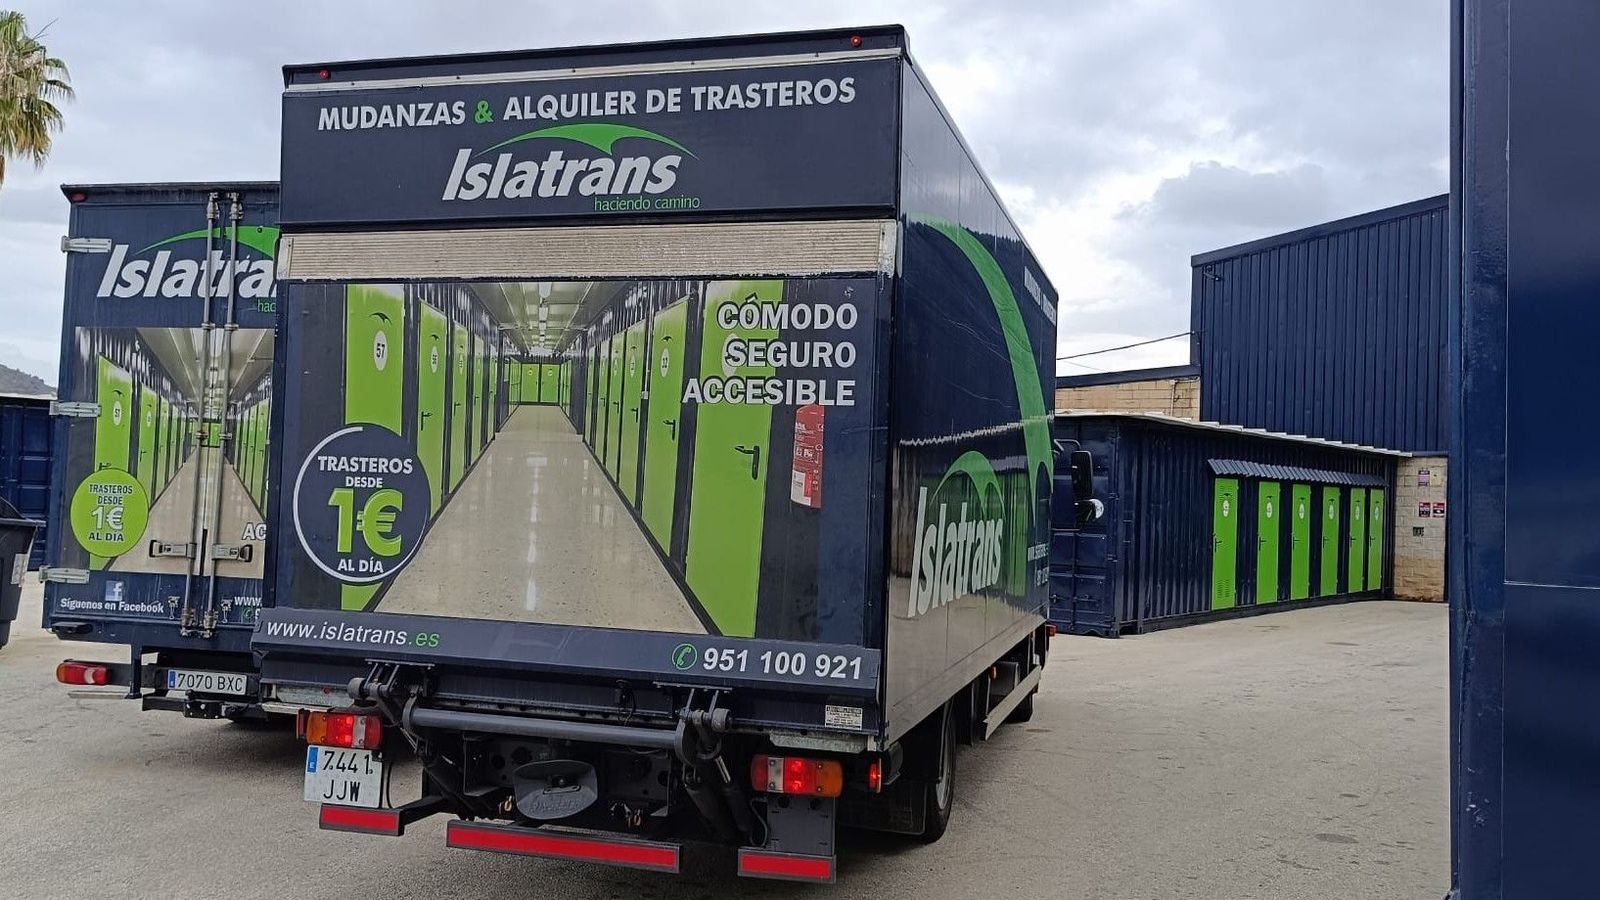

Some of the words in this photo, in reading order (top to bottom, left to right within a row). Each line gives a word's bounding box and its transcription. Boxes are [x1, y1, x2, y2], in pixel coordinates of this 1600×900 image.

[318, 100, 466, 131] MUDANZAS
[474, 99, 494, 124] &
[503, 92, 637, 120] ALQUILER
[646, 87, 682, 114] DE
[690, 76, 856, 112] TRASTEROS
[442, 148, 682, 201] Islatrans
[594, 196, 651, 212] haciendo
[655, 194, 701, 210] camino
[96, 243, 278, 299] Islatra
[717, 293, 859, 331] CÓMODO
[376, 342, 385, 358] 57
[725, 340, 857, 369] SEGURO
[681, 376, 857, 407] ACCESIBLE
[317, 455, 414, 475] TRASTEROS
[89, 484, 133, 494] TRASTEROS
[345, 476, 383, 488] DESDE
[97, 495, 123, 506] DESDE
[90, 506, 124, 531] 1€
[328, 487, 403, 557] 1€
[88, 532, 103, 541] AL
[105, 530, 124, 542] DÍA
[908, 486, 1004, 618] Islatrans
[337, 558, 355, 572] AL
[359, 556, 384, 573] DÍA
[60, 597, 103, 611] Síguenos
[104, 600, 116, 611] en
[118, 600, 164, 613] Facebook
[266, 621, 440, 648] www.islatrans.es
[703, 647, 748, 672] 951
[760, 651, 806, 676] 100
[815, 654, 862, 680] 921
[176, 673, 213, 690] 7070
[216, 675, 243, 691] BXC
[323, 779, 361, 802] JJW
